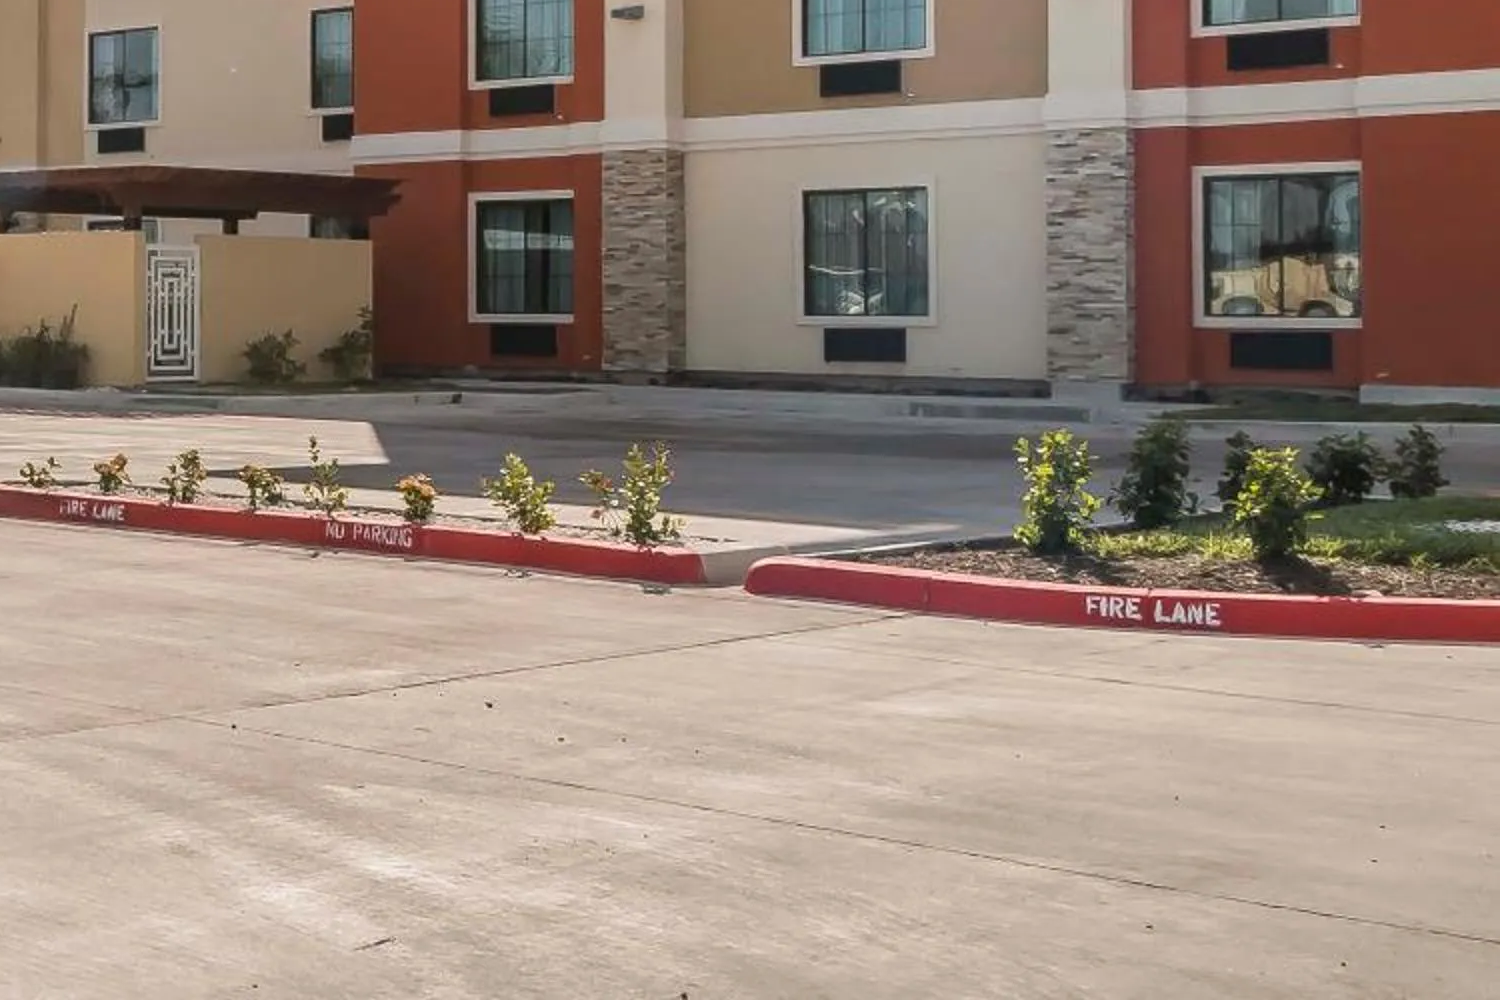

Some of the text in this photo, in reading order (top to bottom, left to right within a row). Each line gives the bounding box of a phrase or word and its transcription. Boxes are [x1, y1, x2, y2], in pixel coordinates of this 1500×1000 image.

[325, 521, 413, 548] NO PARKING
[1085, 595, 1222, 627] FIRE LANE
